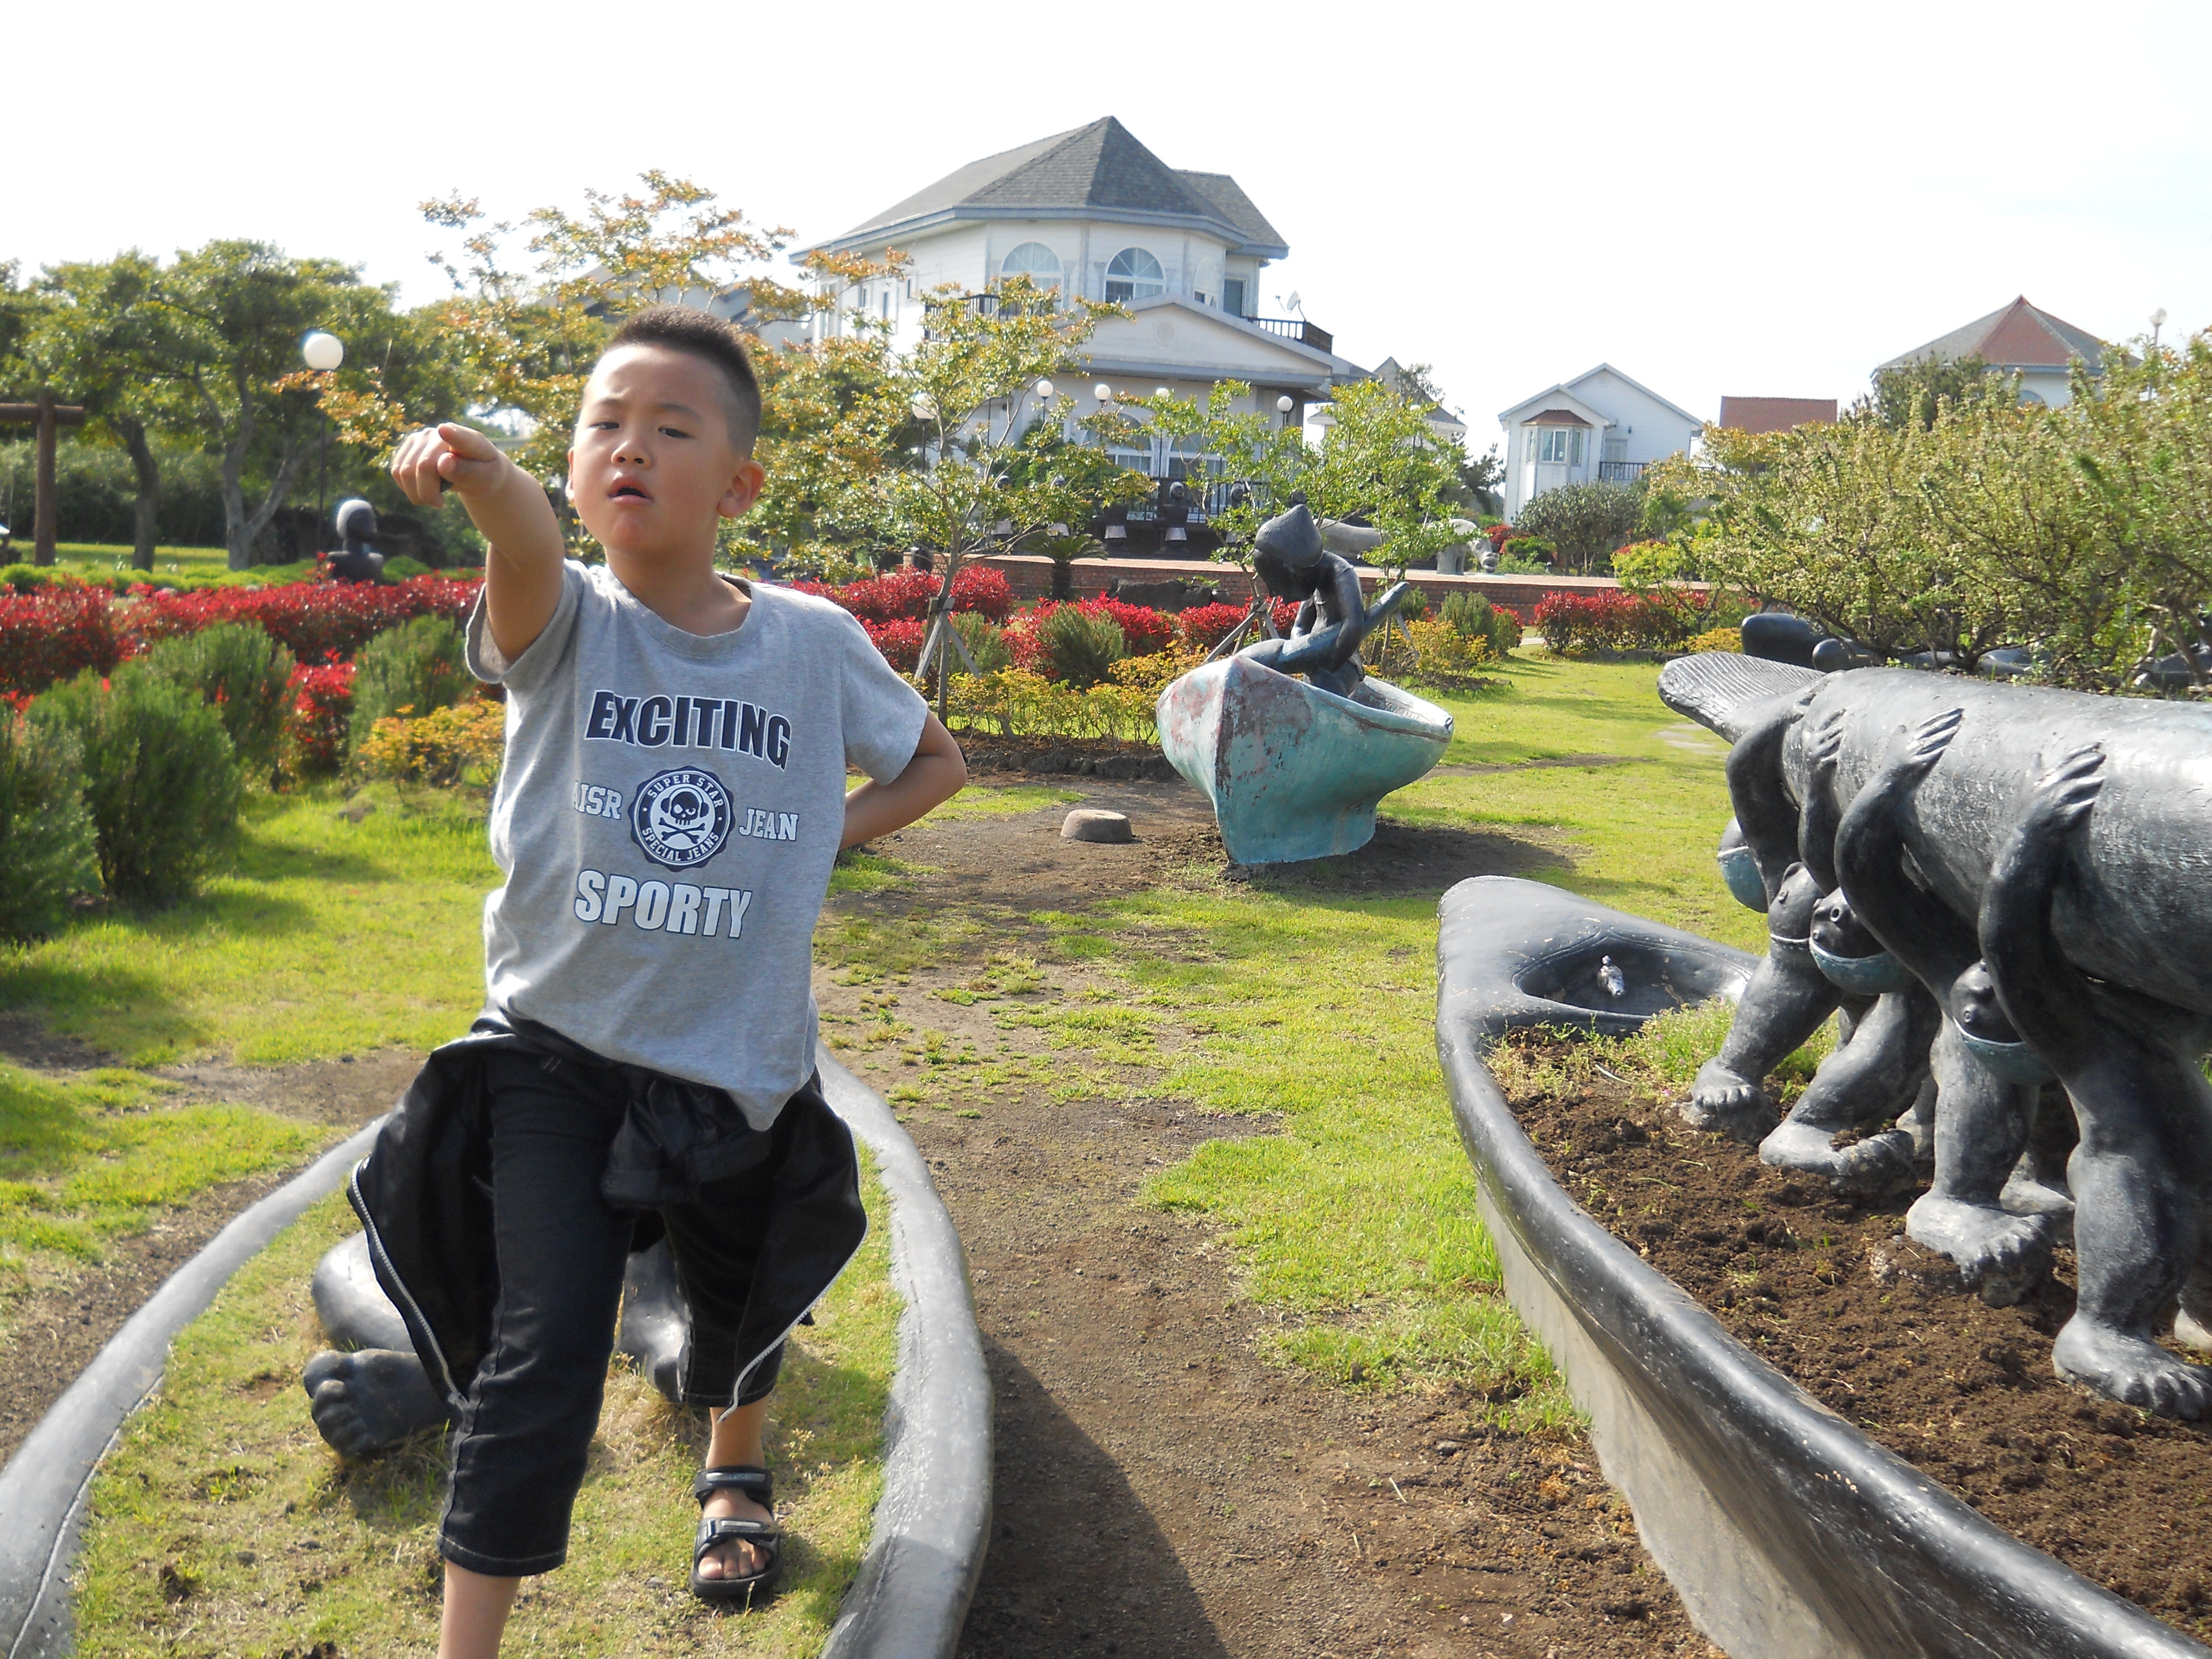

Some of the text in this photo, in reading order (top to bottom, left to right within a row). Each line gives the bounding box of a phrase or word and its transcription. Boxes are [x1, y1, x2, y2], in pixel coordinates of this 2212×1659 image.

[584, 690, 791, 773] EXCITING
[647, 774, 724, 808] SUPER STAR
[739, 807, 799, 841] JEAN
[642, 827, 719, 861] SPECIAL JEANS
[573, 869, 753, 939] SPORTY
